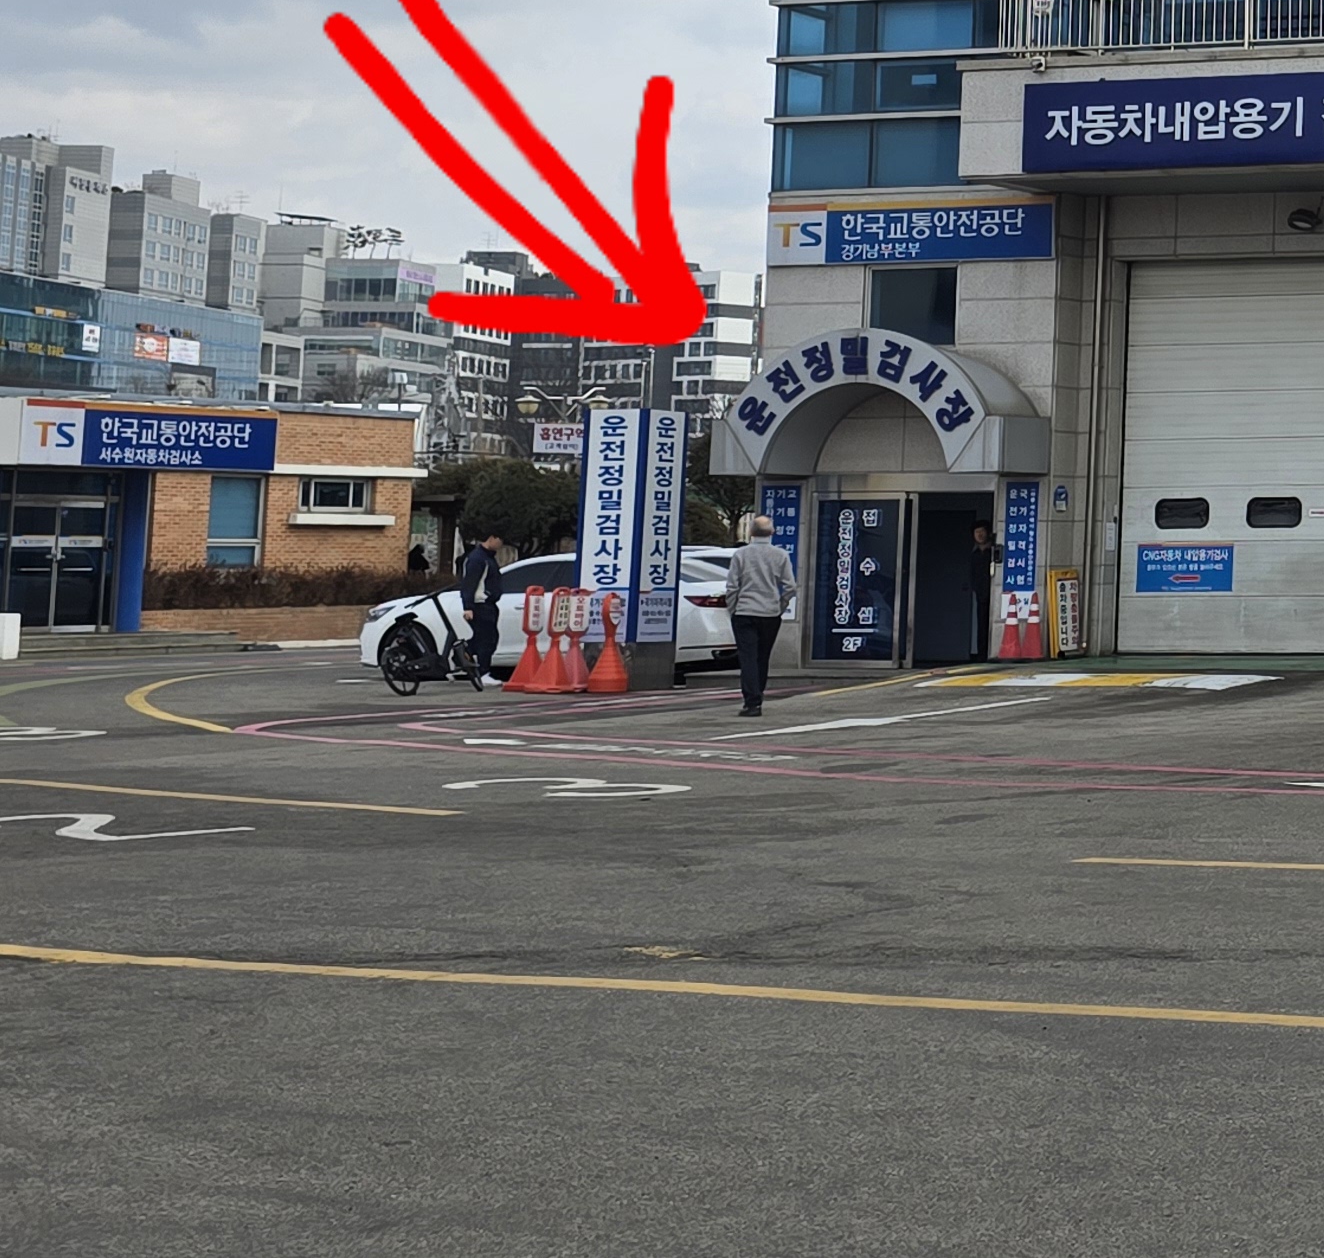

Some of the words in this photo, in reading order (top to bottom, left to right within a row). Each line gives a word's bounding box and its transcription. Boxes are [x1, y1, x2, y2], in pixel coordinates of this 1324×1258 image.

[1044, 96, 1305, 146] 자동차내압용기
[774, 222, 822, 248] TS
[841, 208, 1025, 241] 한국교통안전공단
[841, 242, 921, 261] 경기남부본부
[738, 336, 975, 436] 운전정밀검사장
[33, 421, 76, 447] TS
[100, 416, 252, 449] 한국교통안전공단
[99, 447, 202, 465] 서수원자동차검사소
[593, 415, 628, 586] 운전정밀검사장
[649, 416, 676, 586] 운전정밀검사장
[834, 509, 854, 625] 운전정밀검사장
[858, 509, 878, 625] 접수실
[842, 637, 862, 652] 2F
